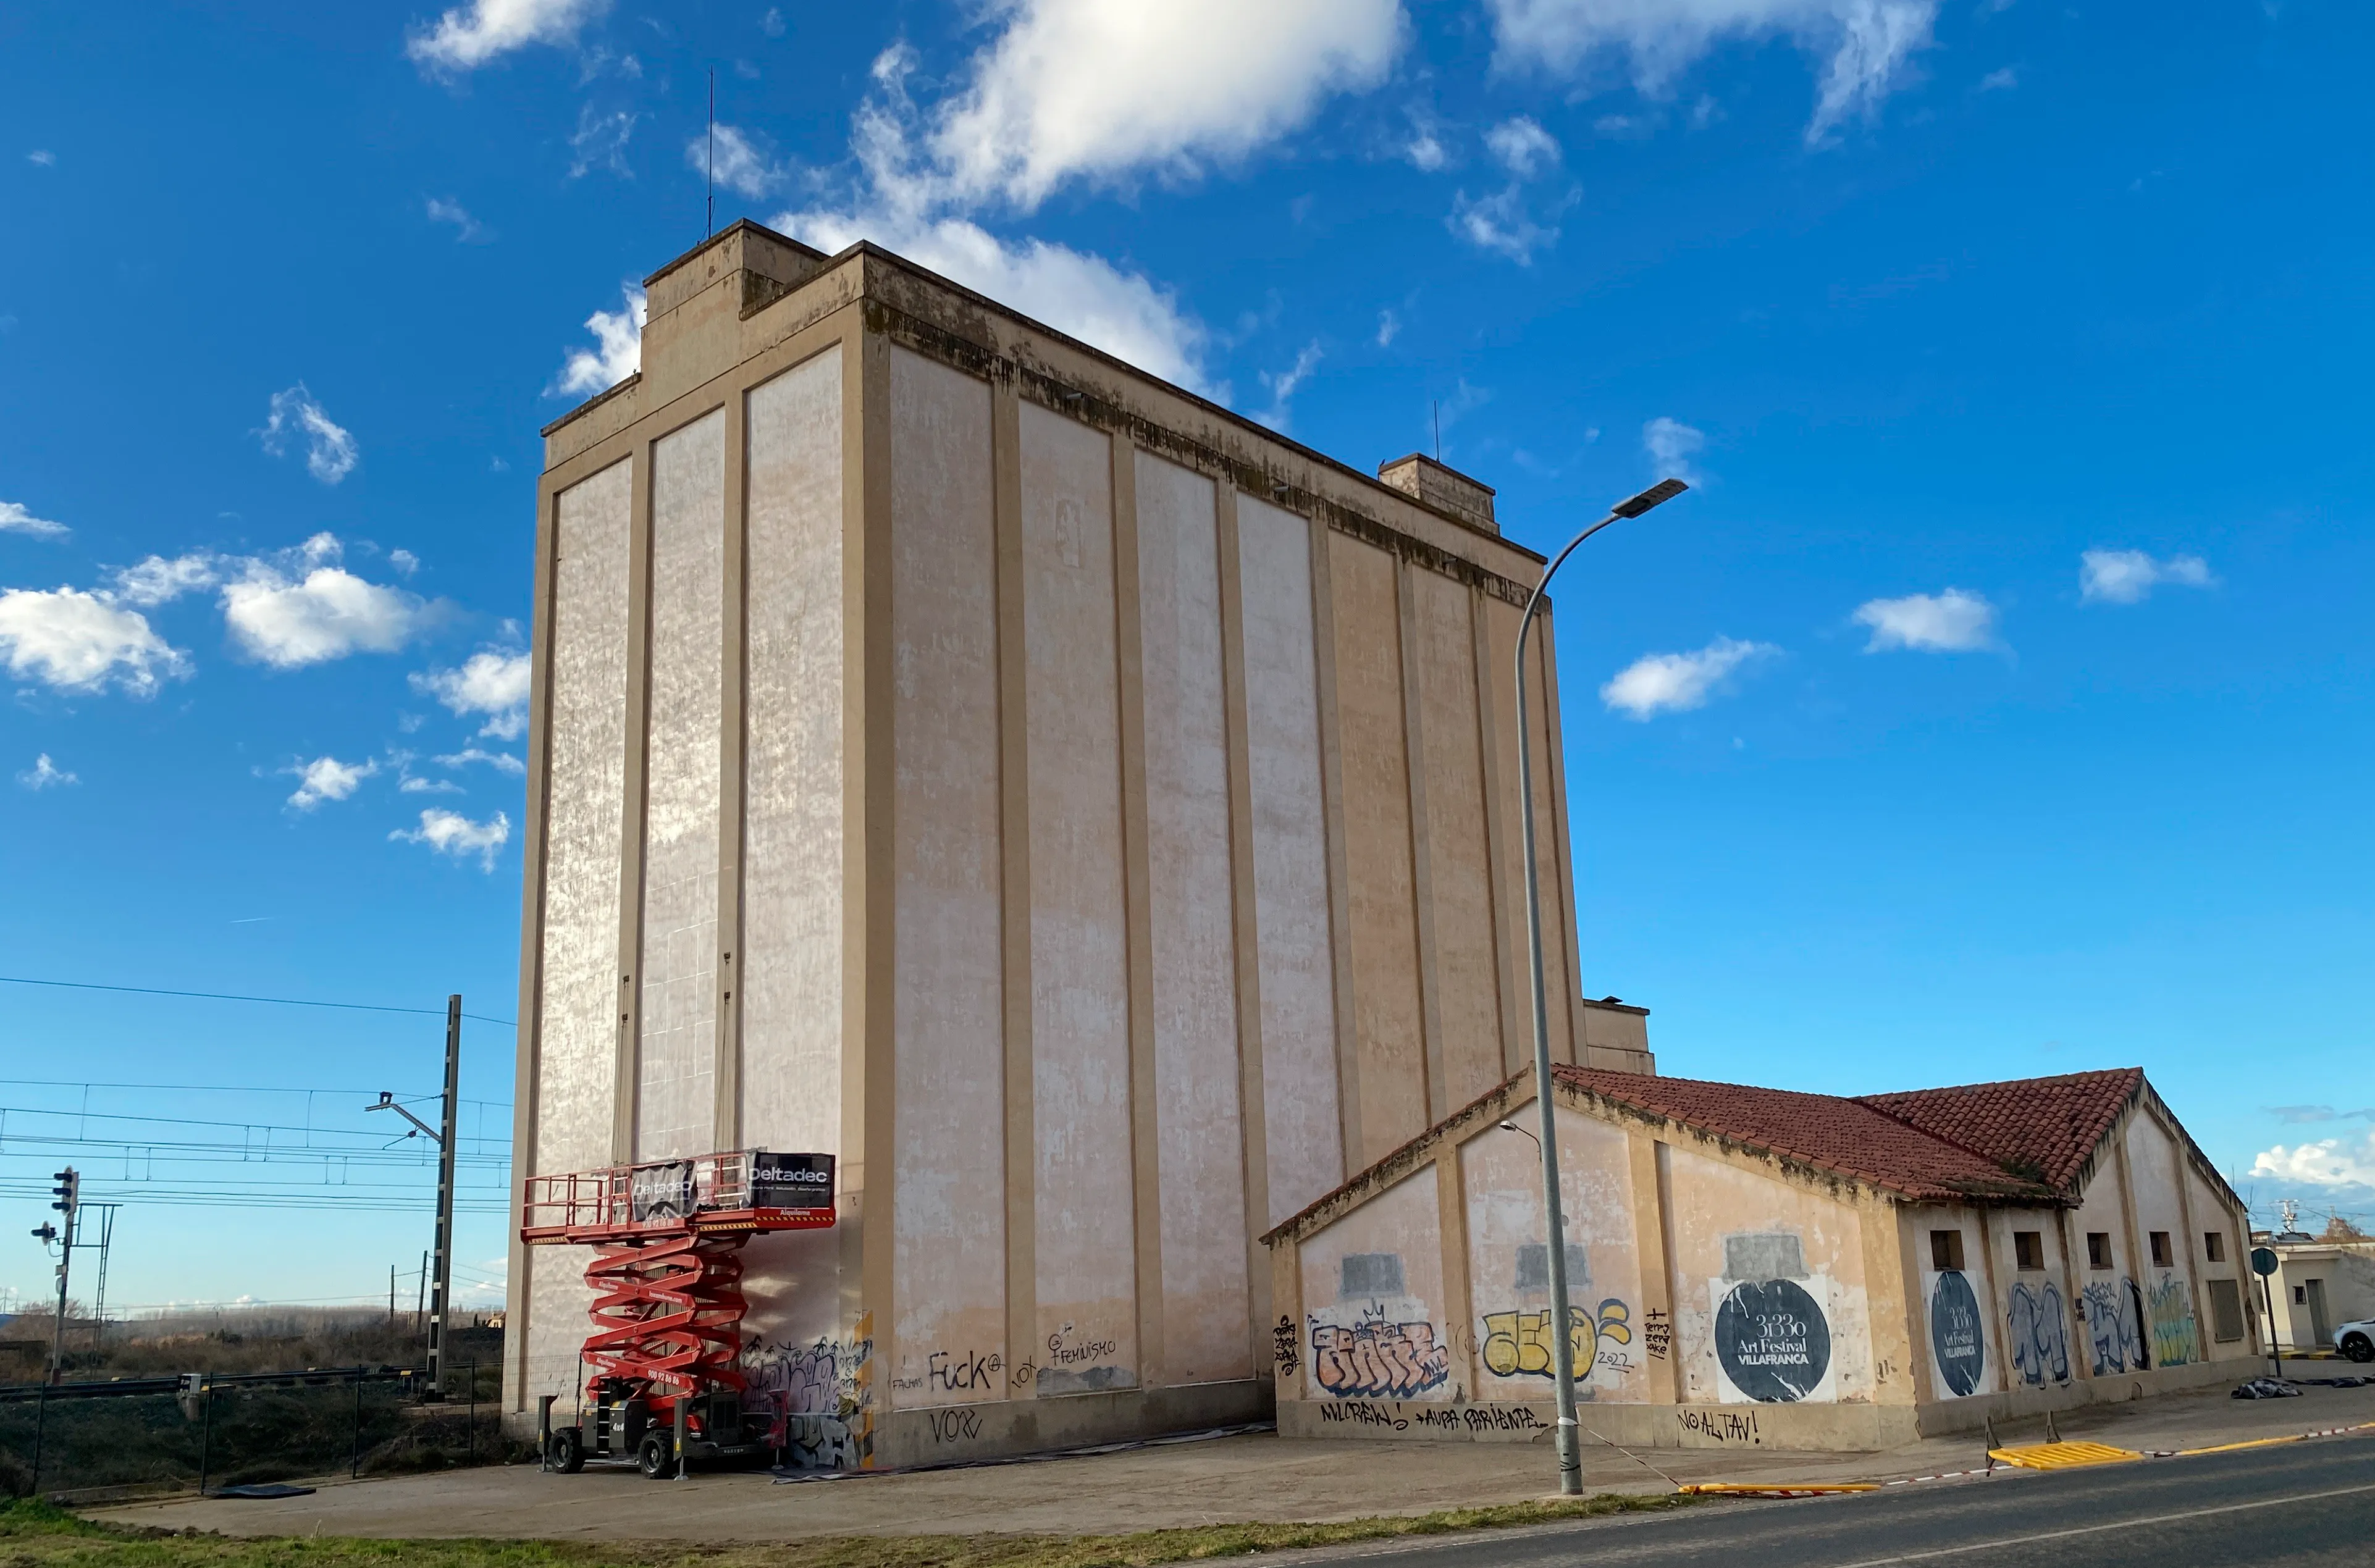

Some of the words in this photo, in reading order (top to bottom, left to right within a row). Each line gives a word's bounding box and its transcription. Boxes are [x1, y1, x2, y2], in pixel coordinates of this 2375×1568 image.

[748, 1167, 827, 1183] Deltadec
[1738, 1338, 1759, 1354] Art
[1760, 1338, 1807, 1353] Festival
[1597, 1351, 1635, 1369] 2022
[1738, 1353, 1809, 1365] VILLAFRANCA
[648, 1369, 657, 1380] 900
[658, 1372, 665, 1381] 92
[665, 1374, 672, 1383] 86
[672, 1376, 679, 1385] 86
[613, 1423, 624, 1432] 4x4
[1678, 1409, 1699, 1431] NO
